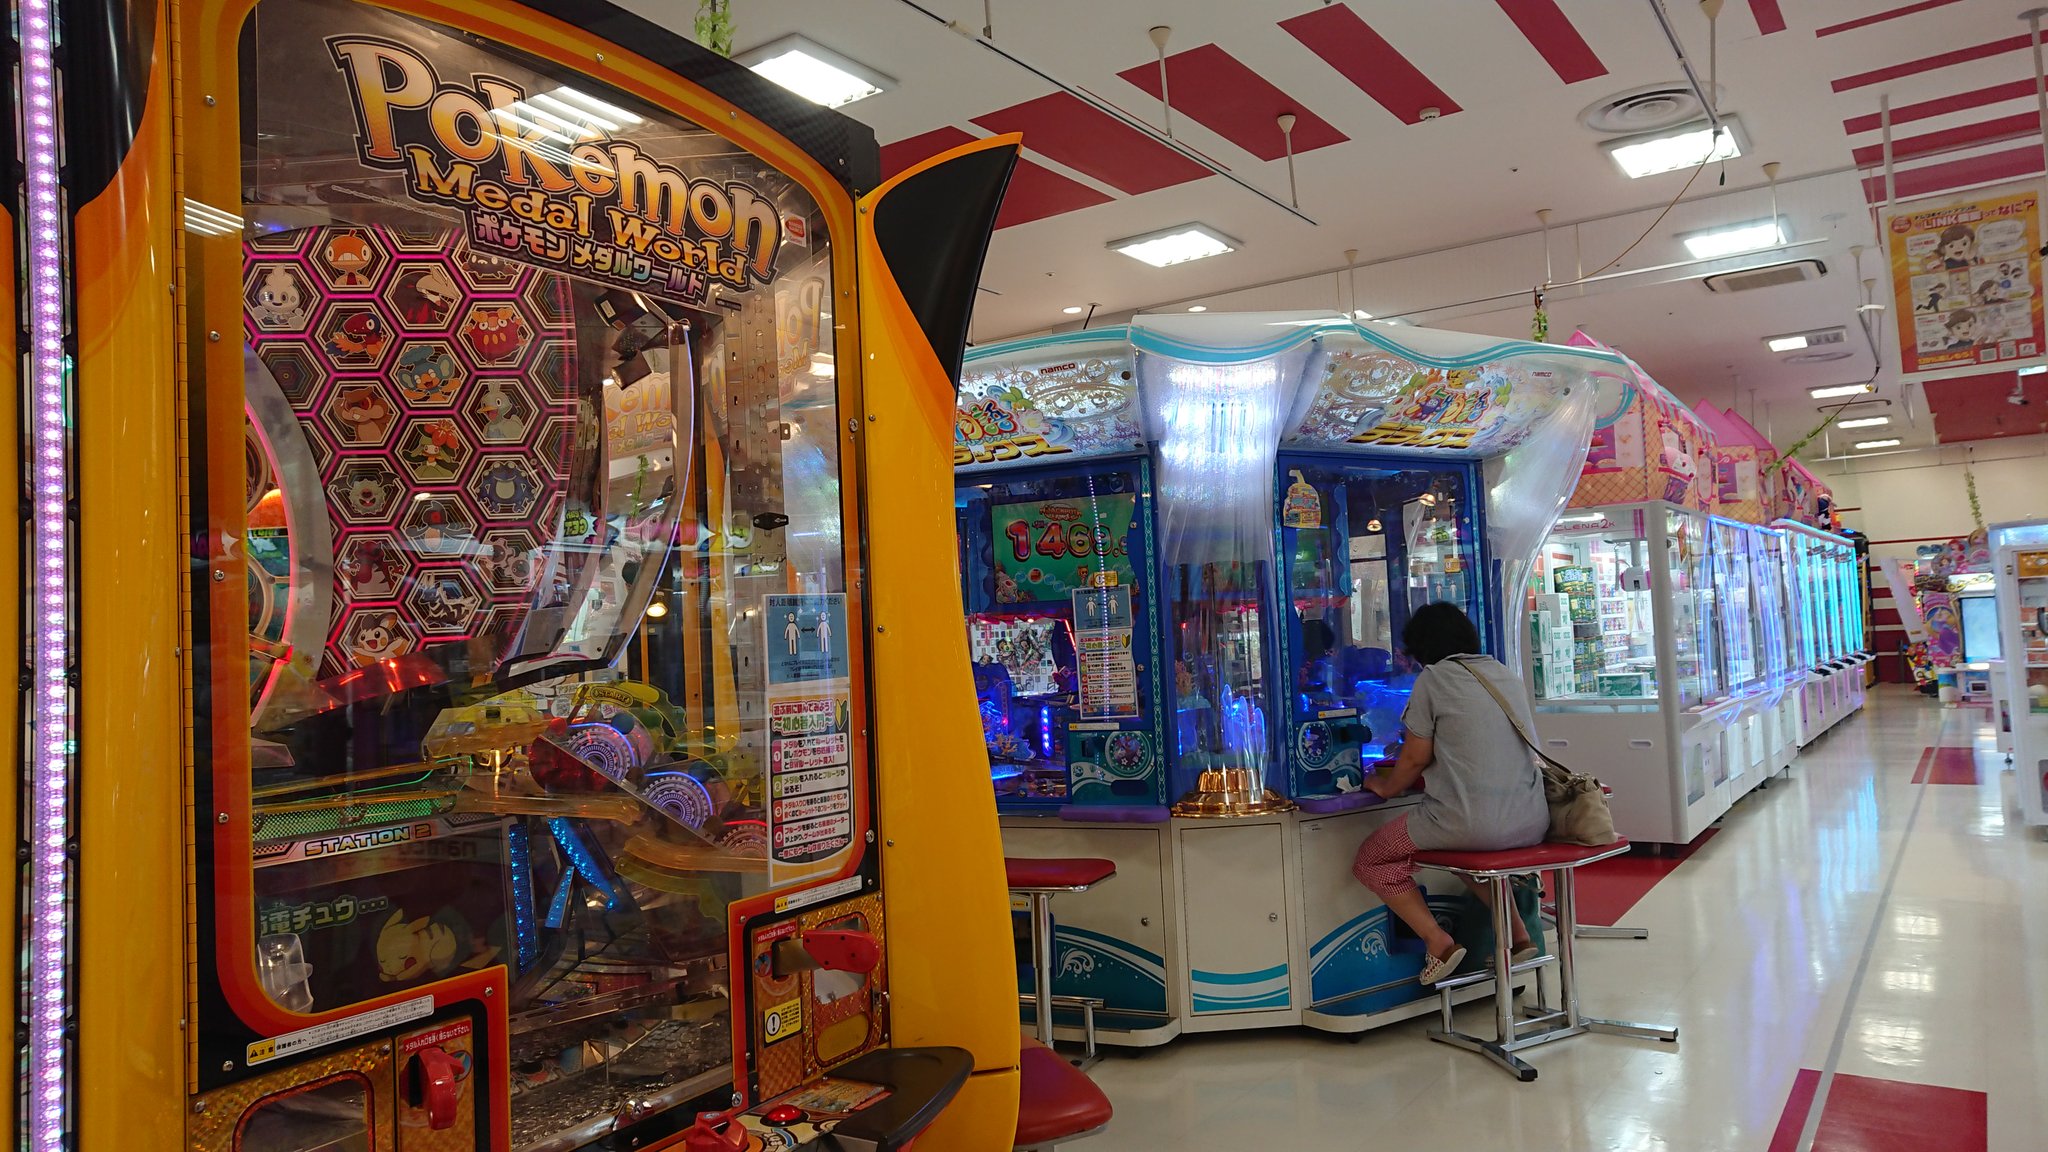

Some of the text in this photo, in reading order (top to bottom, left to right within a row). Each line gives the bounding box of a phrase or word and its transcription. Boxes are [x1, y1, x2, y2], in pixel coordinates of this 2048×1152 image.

[333, 38, 781, 276] Pokémon
[408, 146, 594, 237] Medal
[607, 209, 749, 285] World
[475, 212, 706, 295] ポケモン メダルワールド
[1040, 362, 1076, 375] namco
[304, 823, 433, 857] STATION 2
